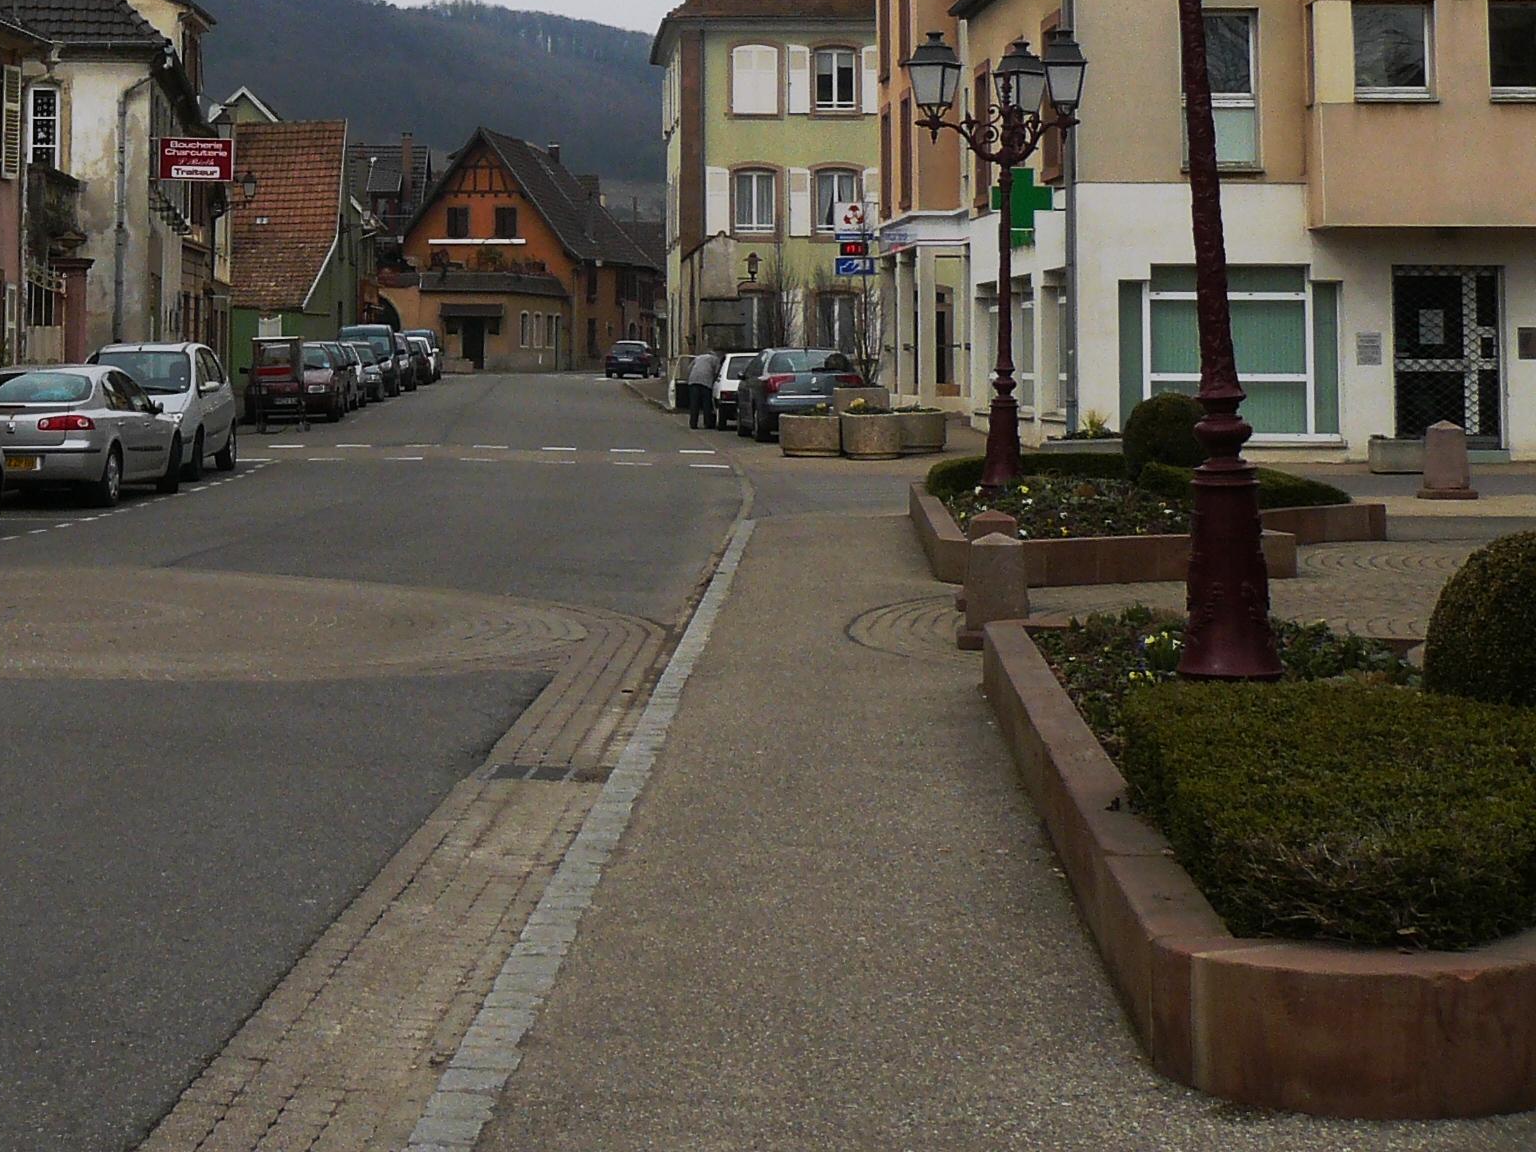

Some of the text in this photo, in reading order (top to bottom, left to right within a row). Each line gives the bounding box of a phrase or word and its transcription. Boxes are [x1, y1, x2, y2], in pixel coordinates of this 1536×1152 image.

[169, 140, 223, 149] Boucherie
[164, 148, 228, 157] Charcuterie
[173, 167, 218, 176] Traiteur
